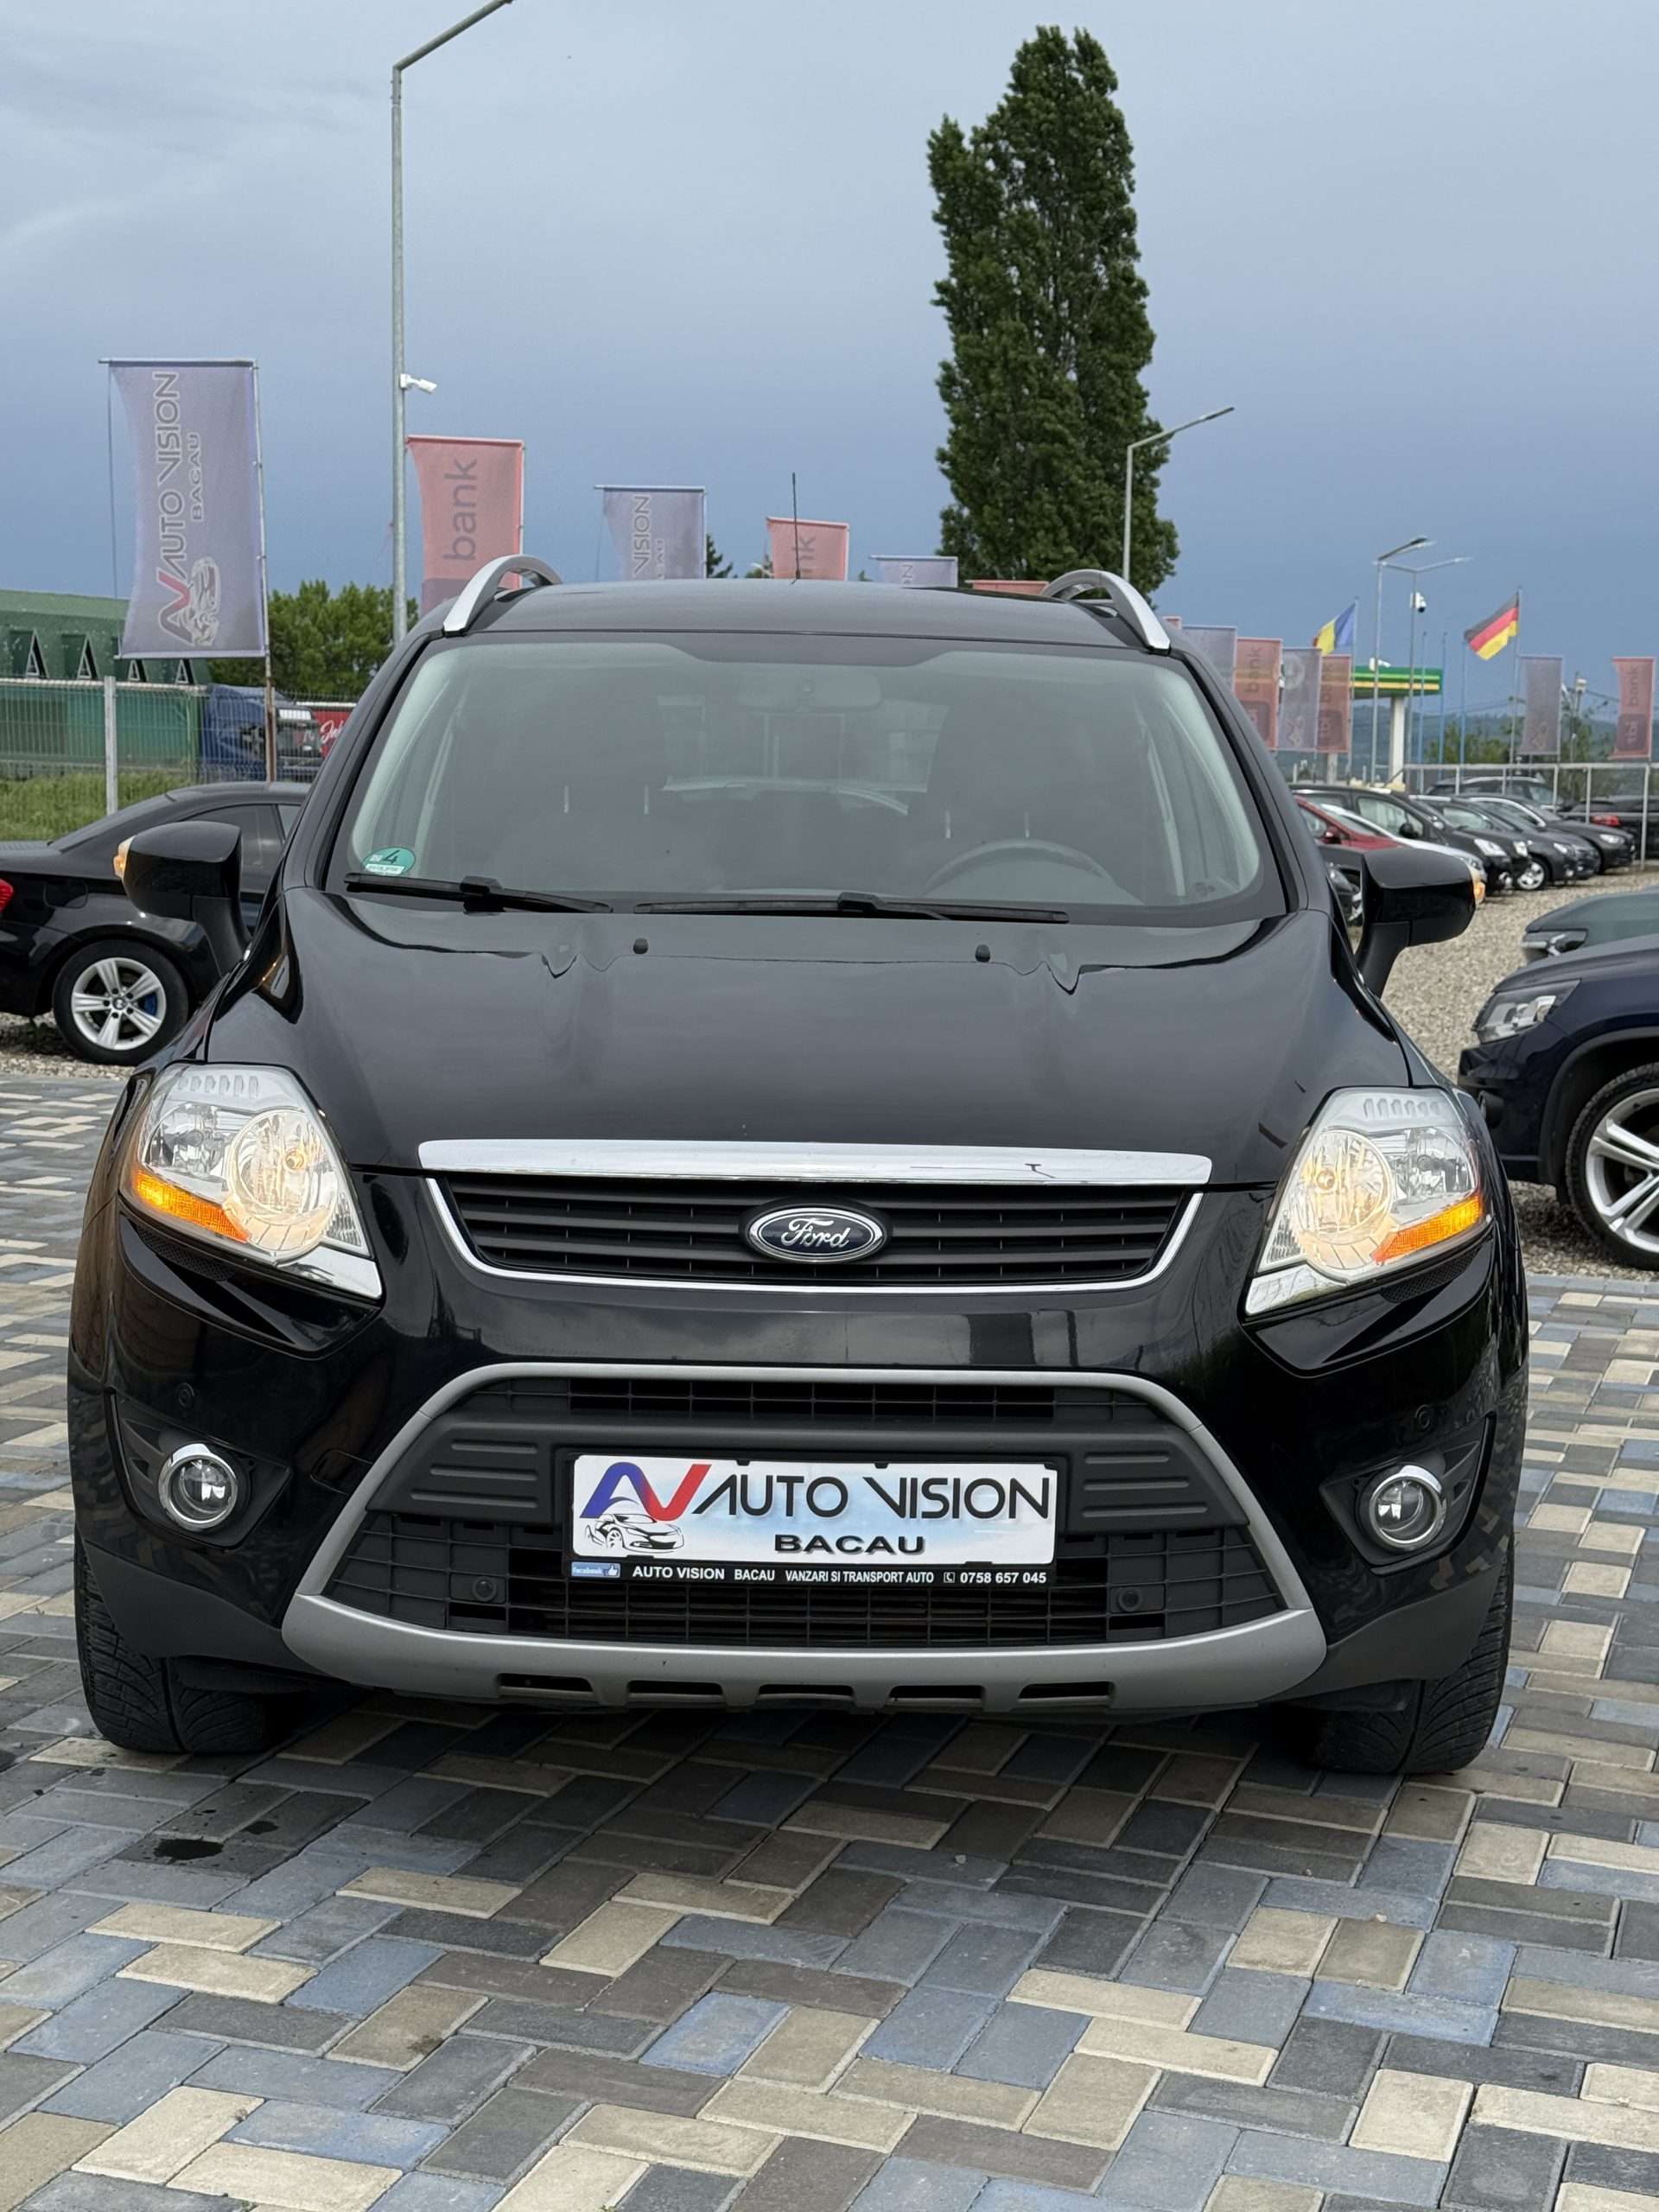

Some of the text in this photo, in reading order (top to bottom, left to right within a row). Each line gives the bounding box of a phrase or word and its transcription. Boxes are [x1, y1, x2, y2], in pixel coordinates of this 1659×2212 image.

[152, 371, 188, 581] AUTO VISION
[188, 432, 204, 522] BACAU
[443, 458, 477, 562] bank
[632, 493, 652, 577] VISION
[383, 849, 401, 864] 4
[781, 1217, 851, 1248] Ford
[690, 1474, 1050, 1520] AUTO VISION
[774, 1535, 925, 1555] BACAU
[632, 1566, 1046, 1584] AUTO VISION BACAU VANZARI SI TRANSPORT AUTO 0758 657 045
